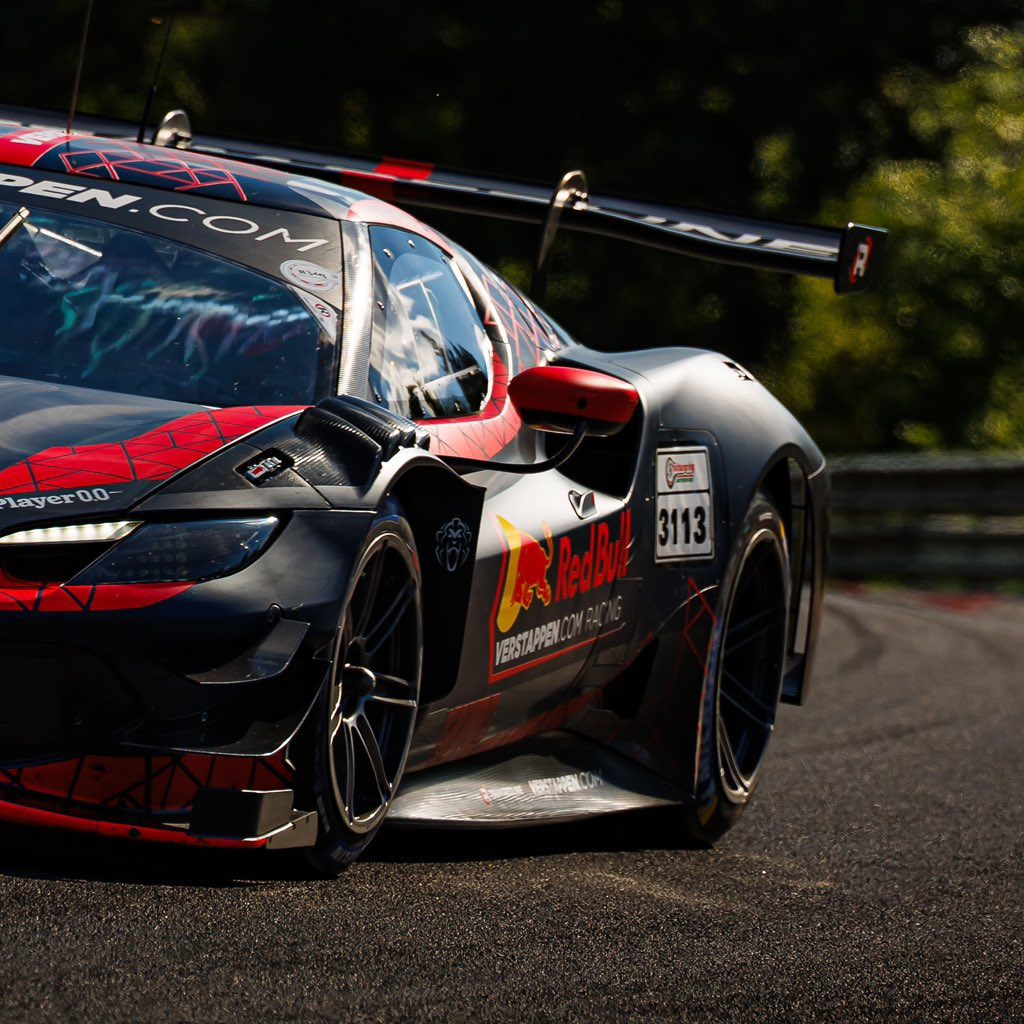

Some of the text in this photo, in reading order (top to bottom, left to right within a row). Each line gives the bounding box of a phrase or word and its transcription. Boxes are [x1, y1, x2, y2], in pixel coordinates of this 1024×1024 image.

[554, 509, 631, 603] Red Bull
[658, 506, 707, 546] 3113
[495, 595, 623, 666] VERSTAPPEN.COM RACING
